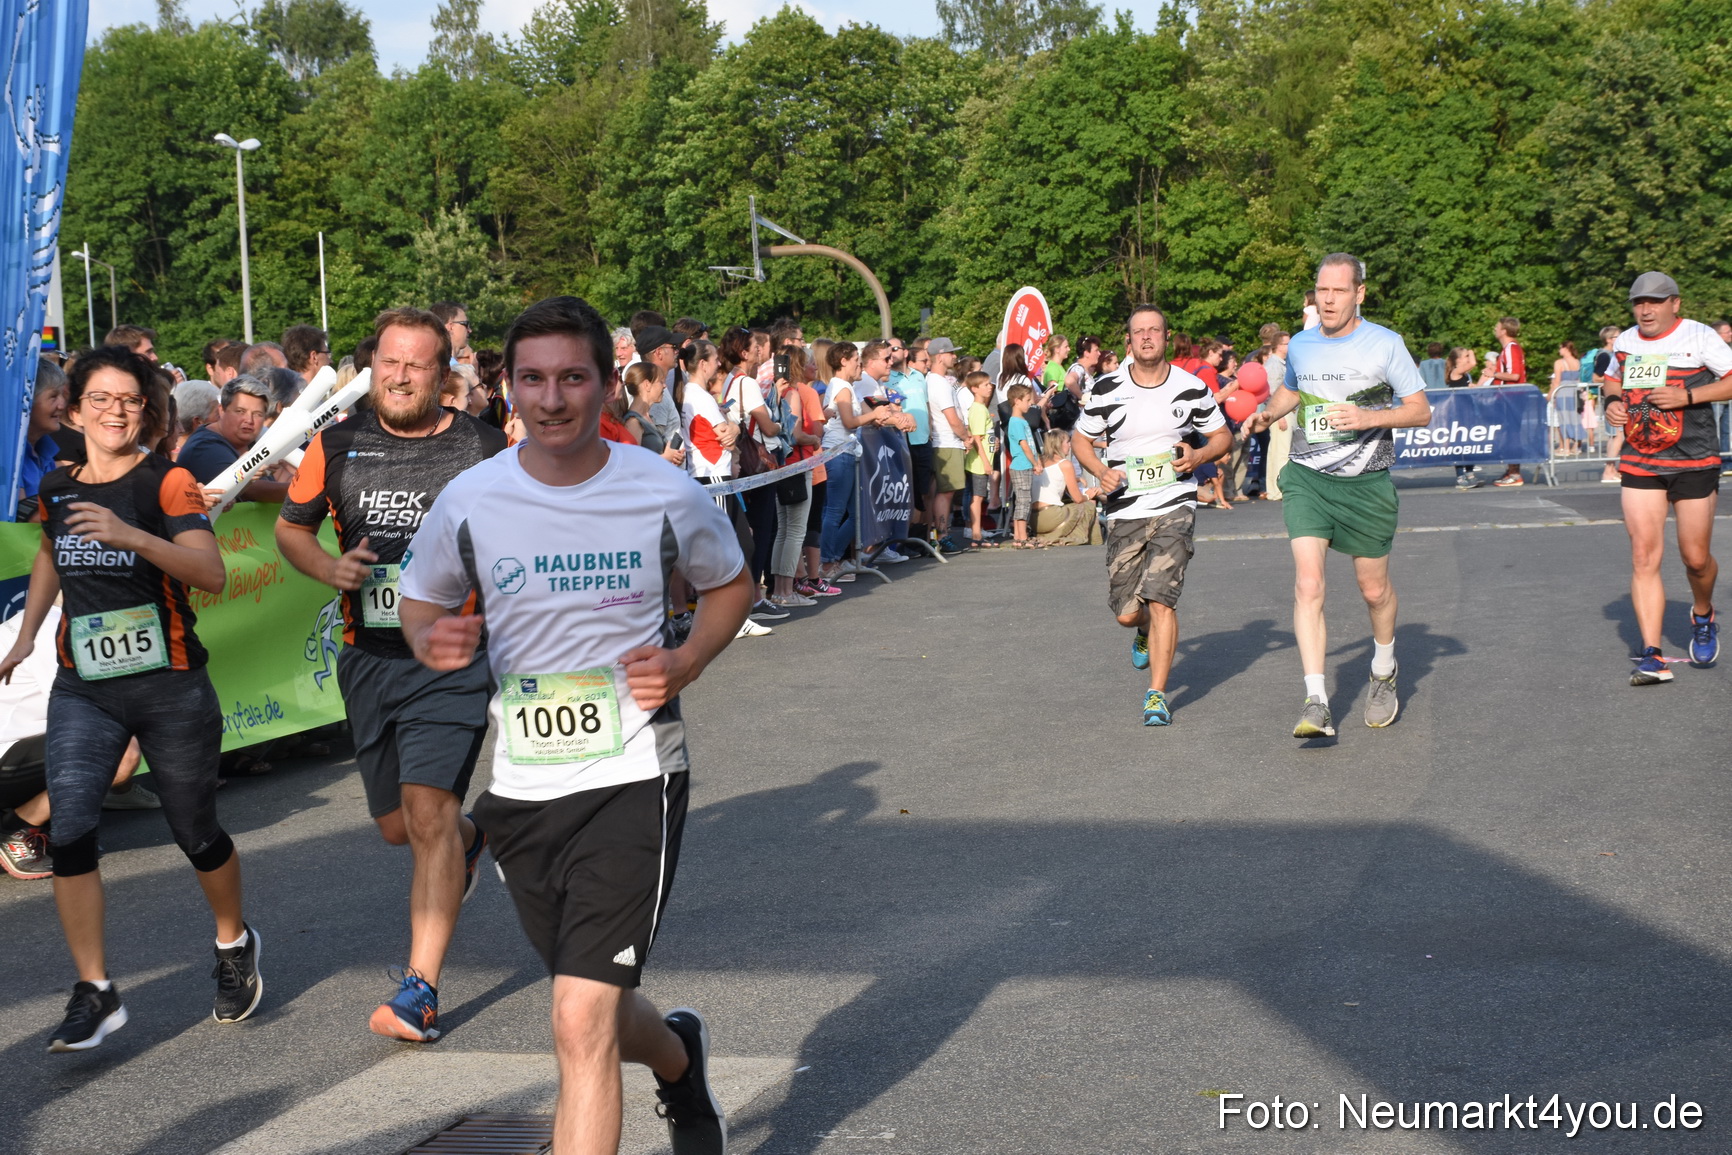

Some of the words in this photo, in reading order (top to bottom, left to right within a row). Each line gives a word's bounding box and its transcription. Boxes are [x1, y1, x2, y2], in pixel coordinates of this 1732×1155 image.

[1629, 365, 1661, 379] 2240
[1310, 417, 1337, 432] 19
[1399, 444, 1493, 459] AUTOMOBILE
[1136, 465, 1164, 481] 797
[358, 490, 427, 509] HECK
[57, 551, 136, 567] DESIGN
[534, 550, 643, 574] HAUBNER
[229, 548, 285, 604] länger!
[547, 574, 630, 593] TREPPEN
[369, 587, 402, 610] 10
[84, 629, 152, 661] 1015
[516, 702, 601, 738] 1008
[556, 737, 589, 747] Florian
